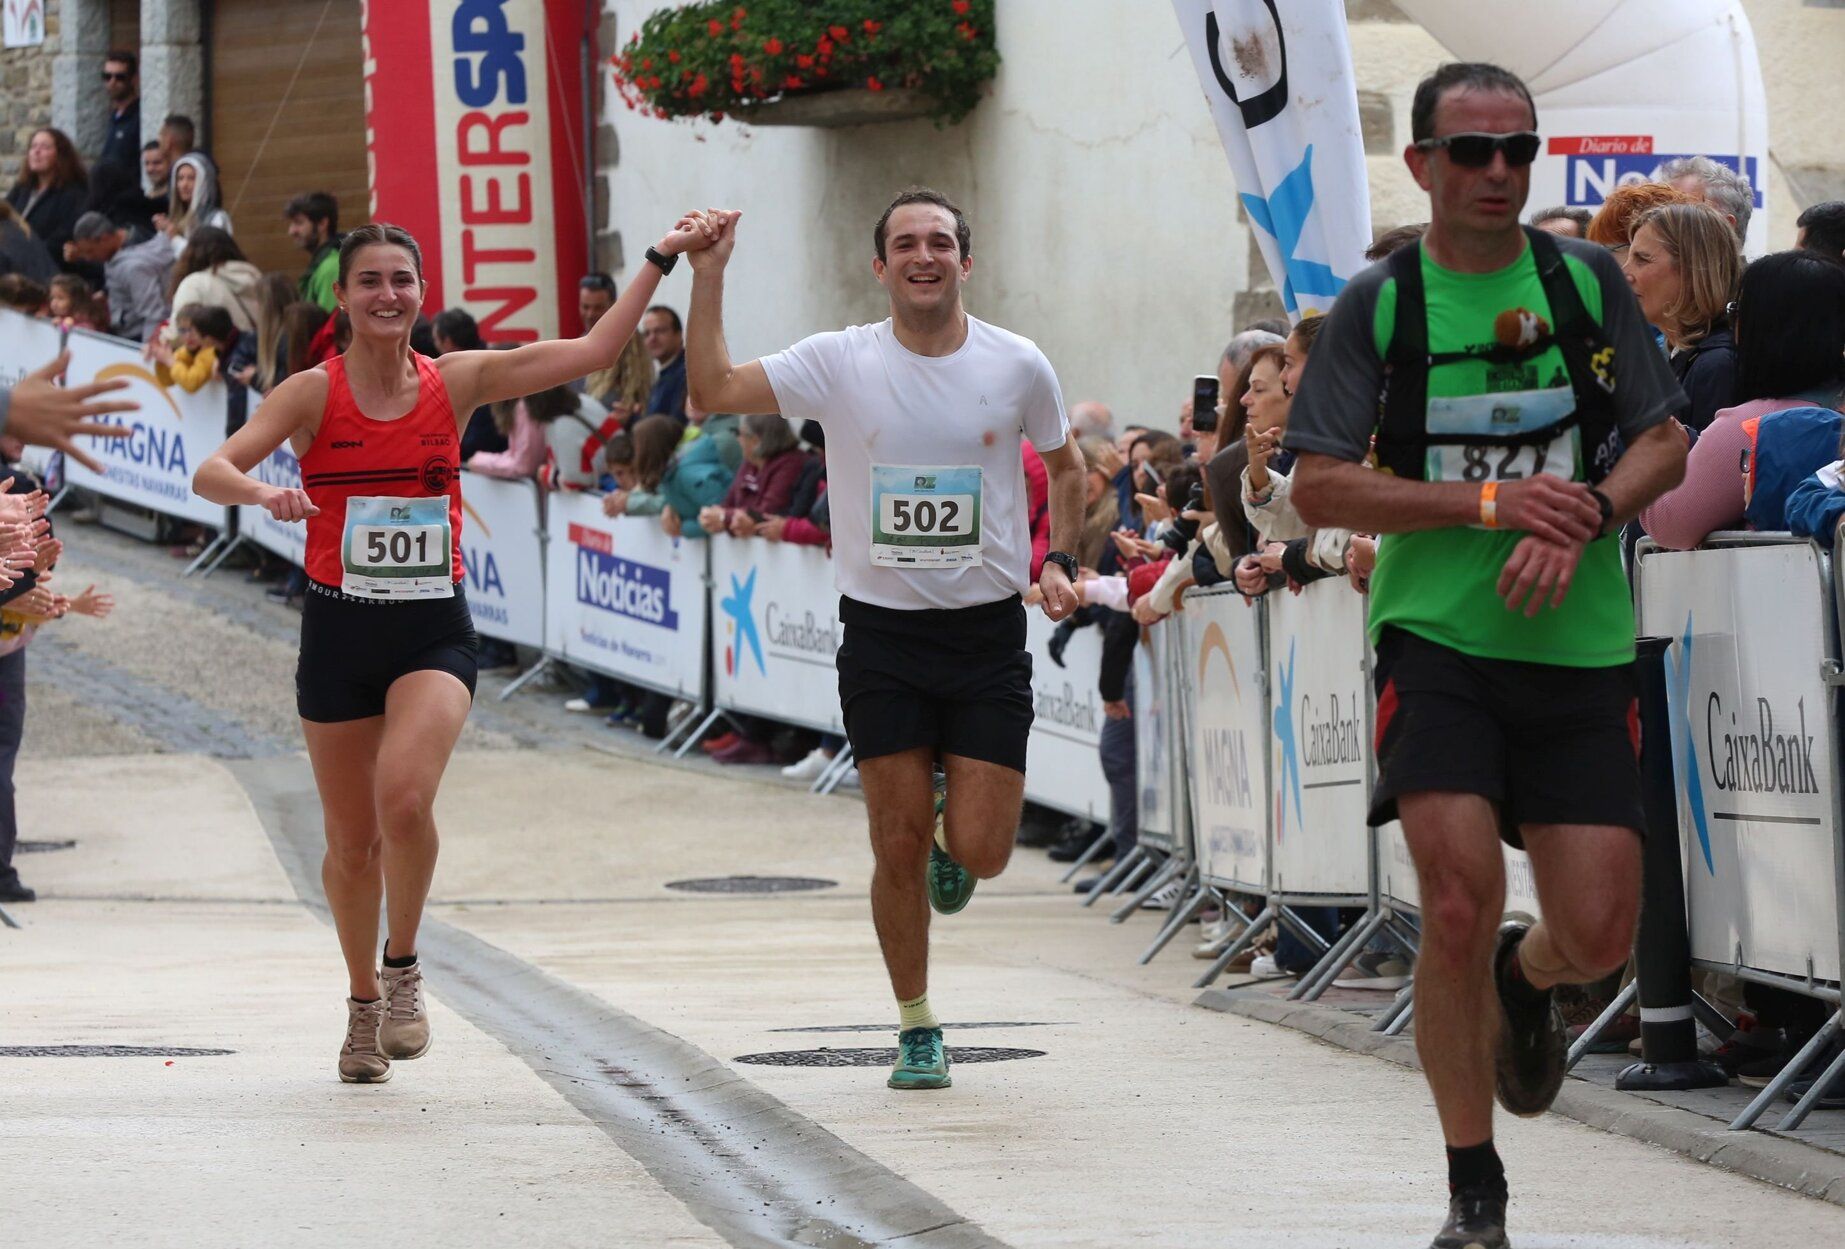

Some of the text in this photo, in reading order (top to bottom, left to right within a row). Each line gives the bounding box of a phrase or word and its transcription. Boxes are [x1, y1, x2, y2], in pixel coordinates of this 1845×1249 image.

[1579, 137, 1650, 154] Diario de
[91, 413, 188, 477] MAGNA
[893, 500, 959, 532] 502
[367, 531, 427, 563] 501
[580, 550, 665, 623] Noticias
[766, 601, 840, 656] CaixaBank
[1035, 681, 1099, 735] aixaBank
[1302, 690, 1362, 768] CaixaBank
[1708, 691, 1819, 794] CaixaBank
